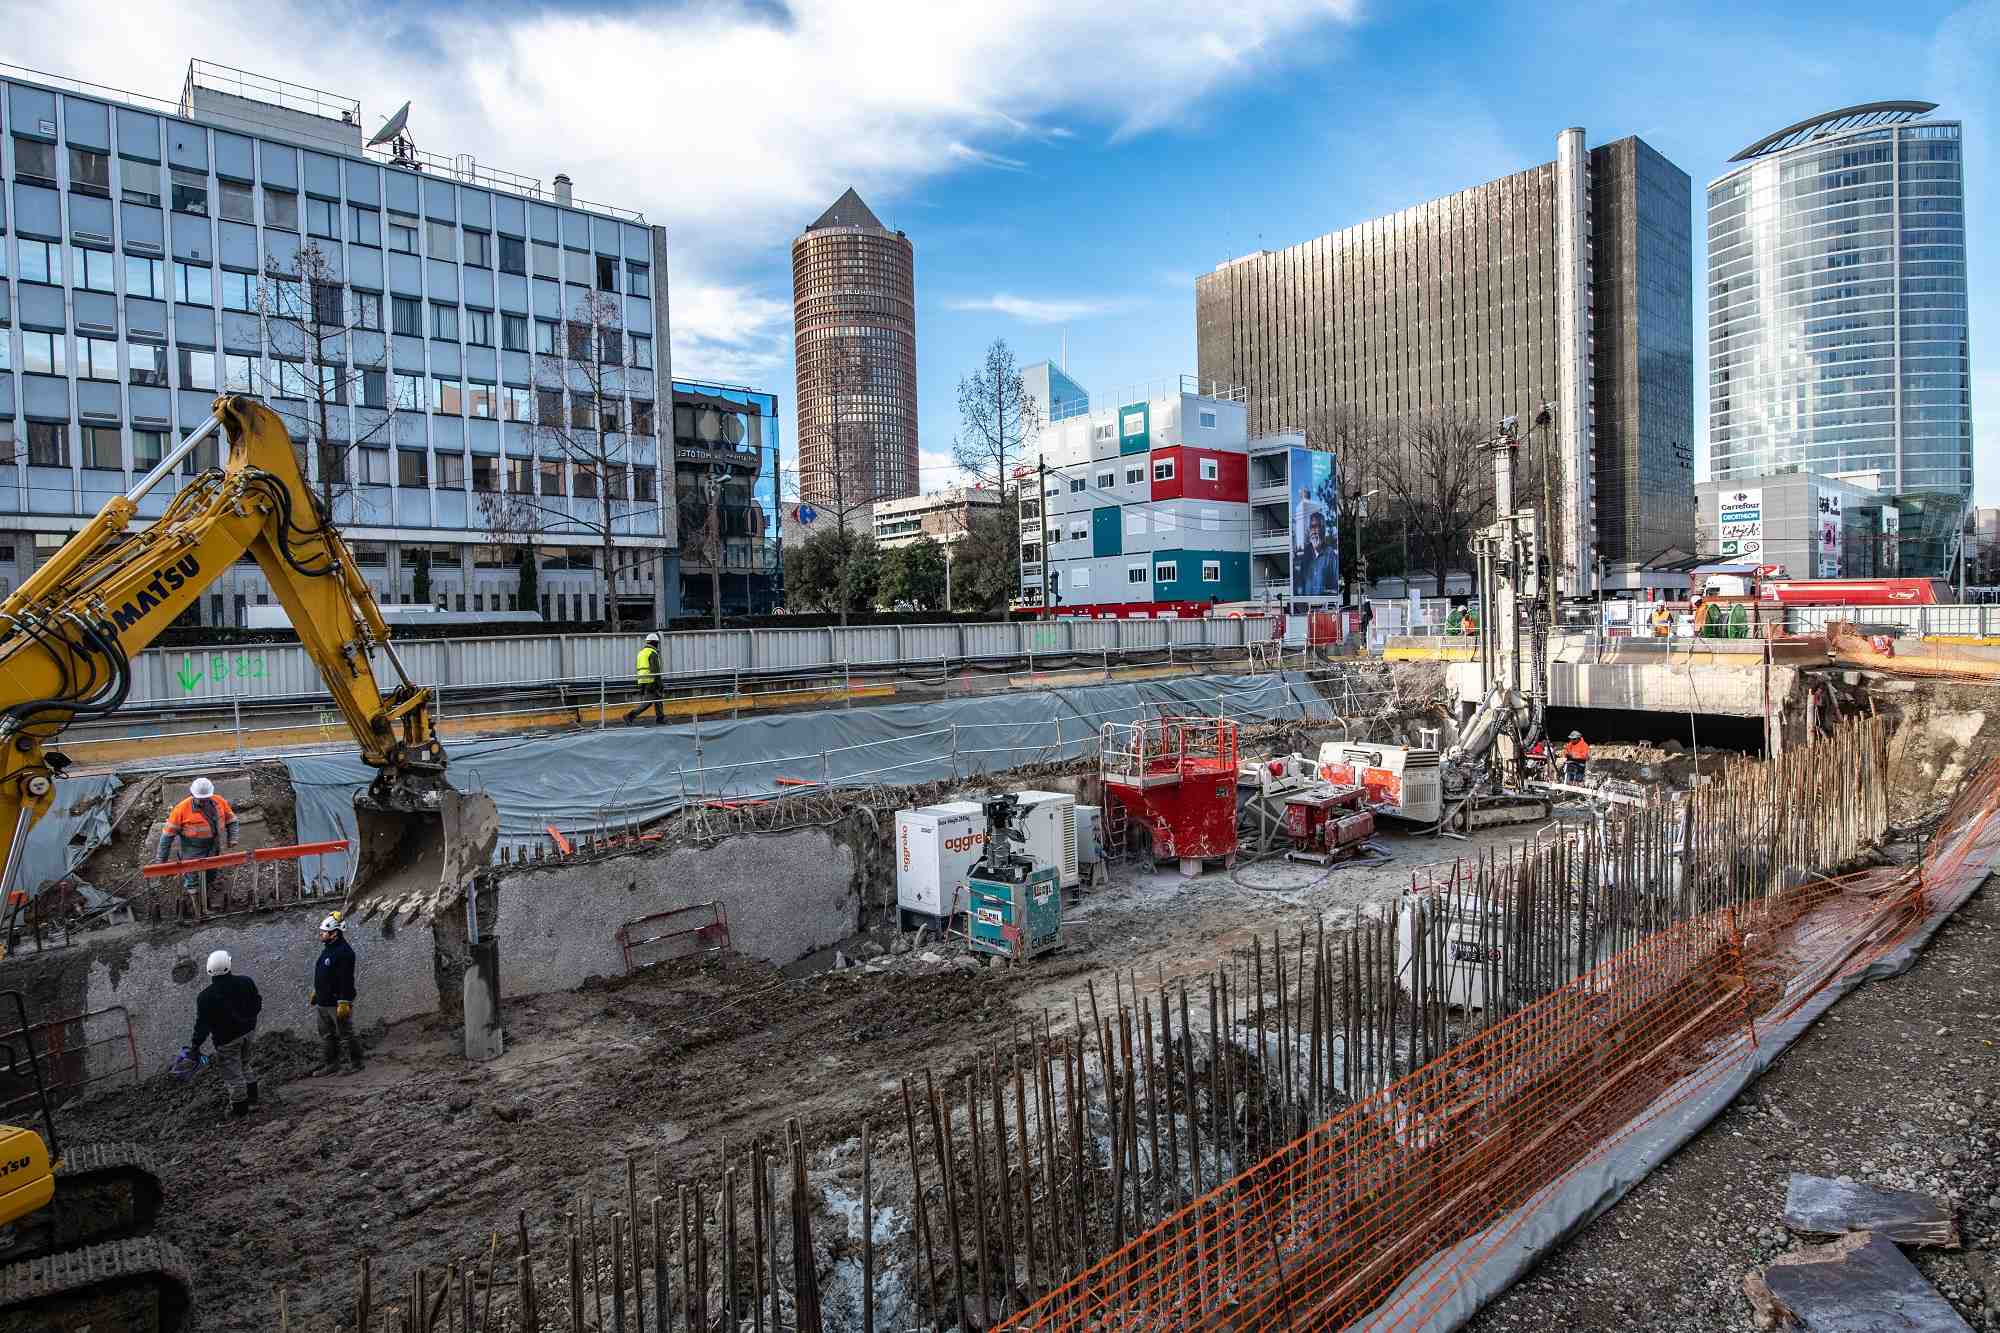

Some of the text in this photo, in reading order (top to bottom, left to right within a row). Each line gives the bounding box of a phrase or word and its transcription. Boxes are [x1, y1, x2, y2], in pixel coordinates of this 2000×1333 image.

[1721, 503, 1760, 511] Carrefour
[96, 553, 200, 644] OMATSU
[902, 825, 911, 872] aggreko
[1031, 931, 1056, 948] CUBE
[0, 1156, 31, 1177] TSU
